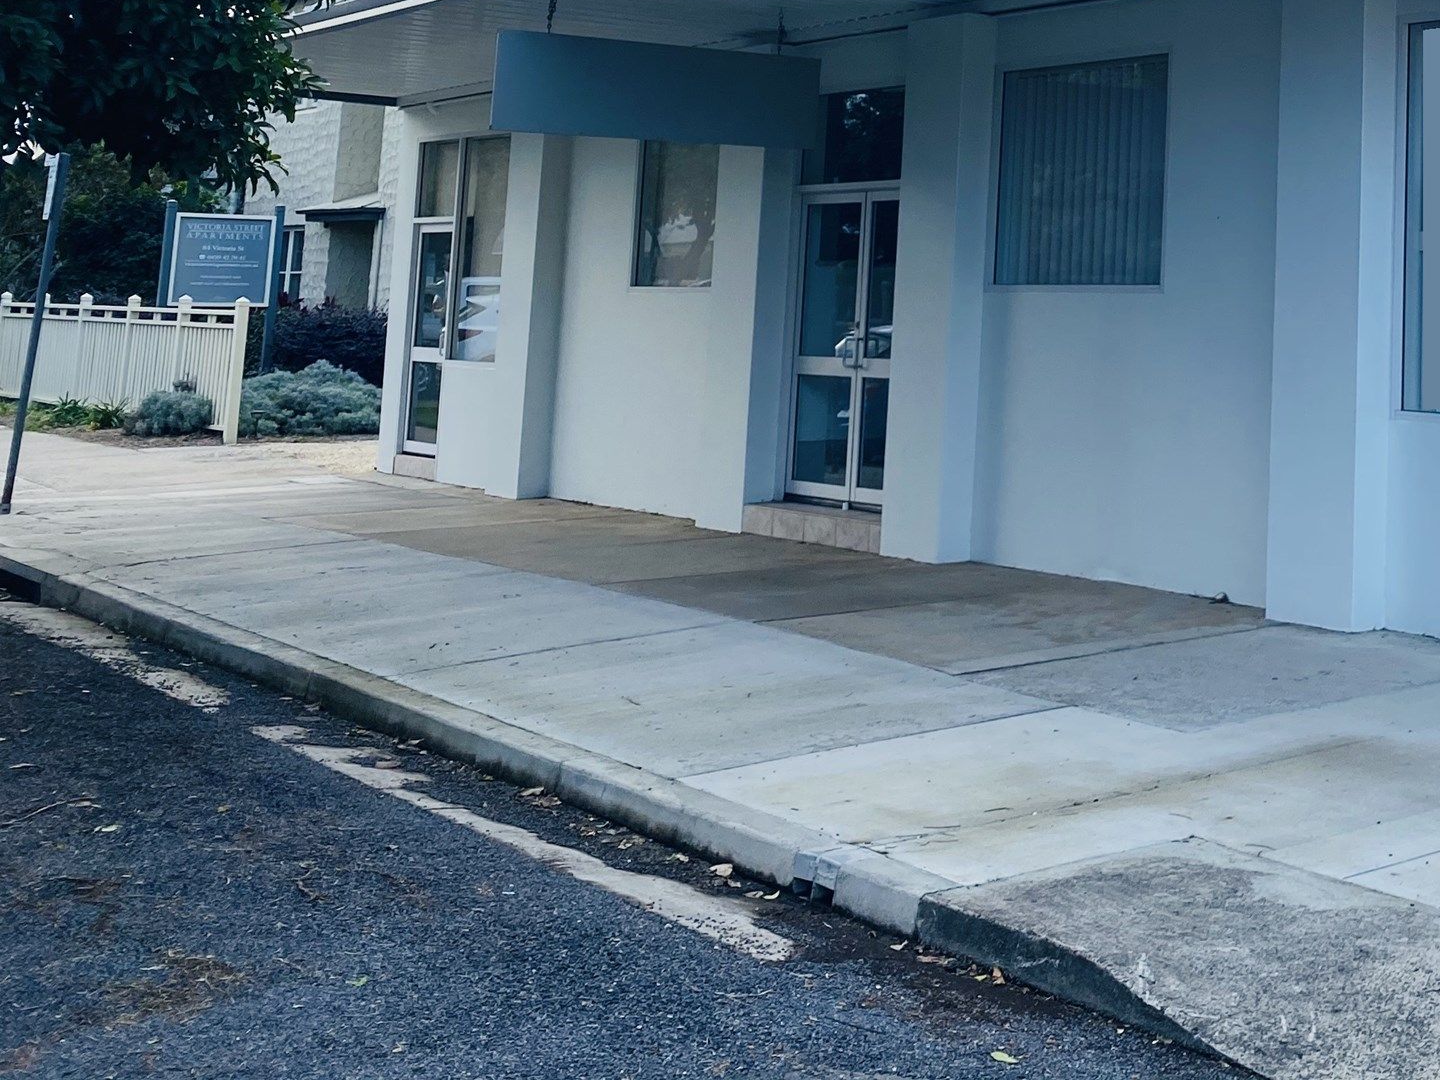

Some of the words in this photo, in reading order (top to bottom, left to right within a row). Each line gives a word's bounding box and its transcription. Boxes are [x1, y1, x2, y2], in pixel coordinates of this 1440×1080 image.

[187, 223, 232, 232] VICTORIA
[234, 224, 264, 232] STREET
[186, 232, 264, 240] APARTMENTS
